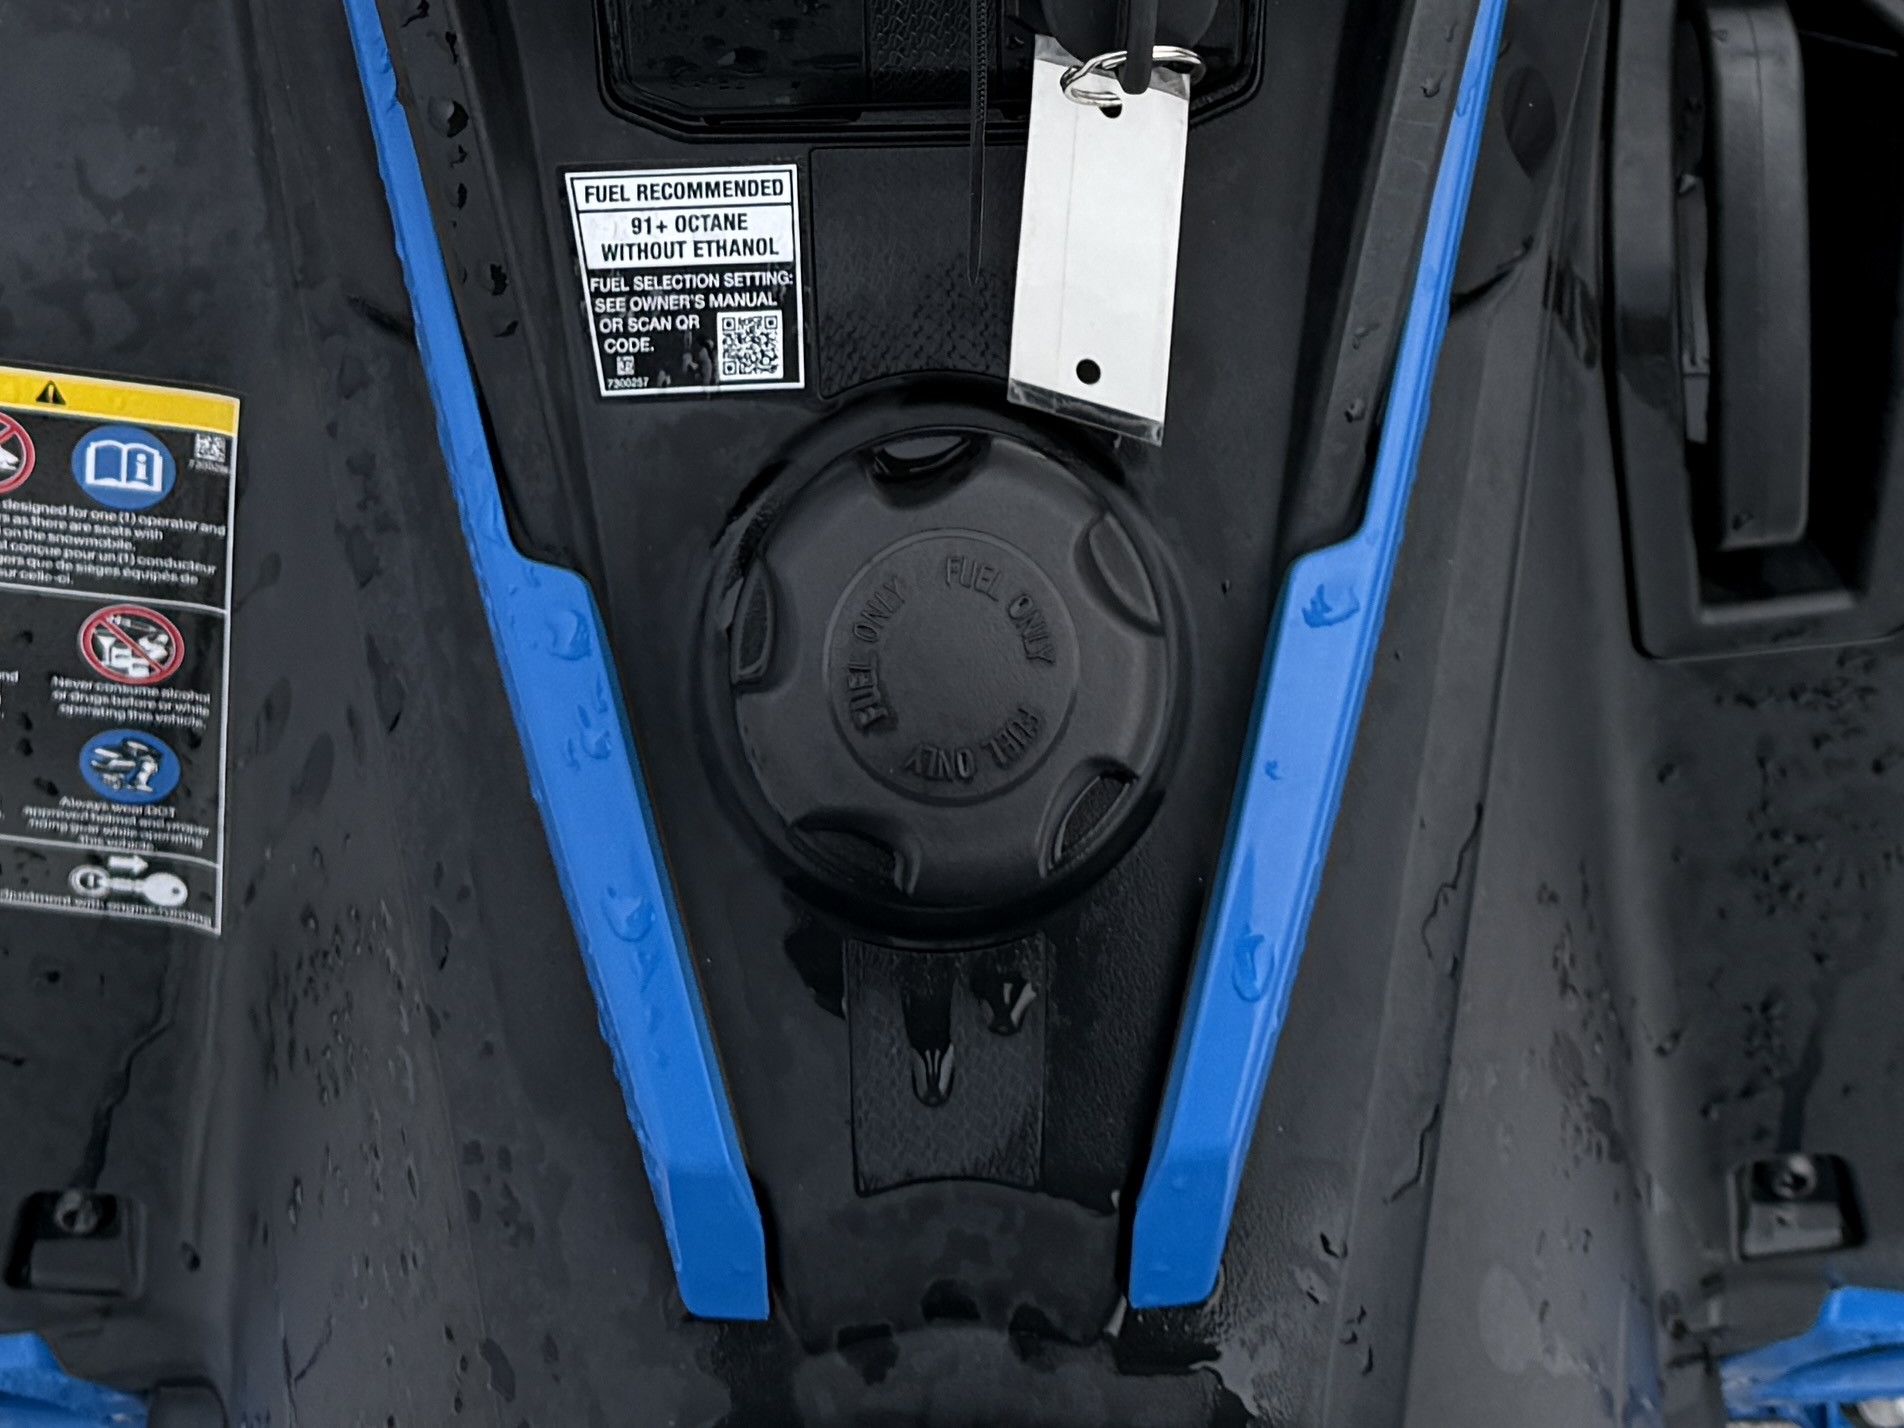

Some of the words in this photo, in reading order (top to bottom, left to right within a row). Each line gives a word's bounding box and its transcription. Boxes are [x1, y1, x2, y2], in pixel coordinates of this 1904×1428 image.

[584, 184, 630, 203] FUEL
[637, 179, 784, 201] RECOMMENDED
[631, 217, 668, 235] 91+
[675, 214, 748, 232] OCTANE
[602, 241, 687, 261] WITHOUT
[694, 237, 779, 257] ETHANOL
[590, 277, 629, 293] FUEL
[634, 274, 720, 290] SELECTION
[724, 271, 793, 287] SETTING:
[595, 298, 625, 312] SEE
[630, 295, 705, 311] OWNER'S
[709, 293, 777, 307] MANUAL
[600, 319, 623, 334] OR
[627, 317, 672, 332] SCAN
[675, 315, 700, 330] QR
[604, 337, 654, 353] CODE.
[944, 554, 999, 602] FUEL
[1007, 594, 1056, 667] ONLY
